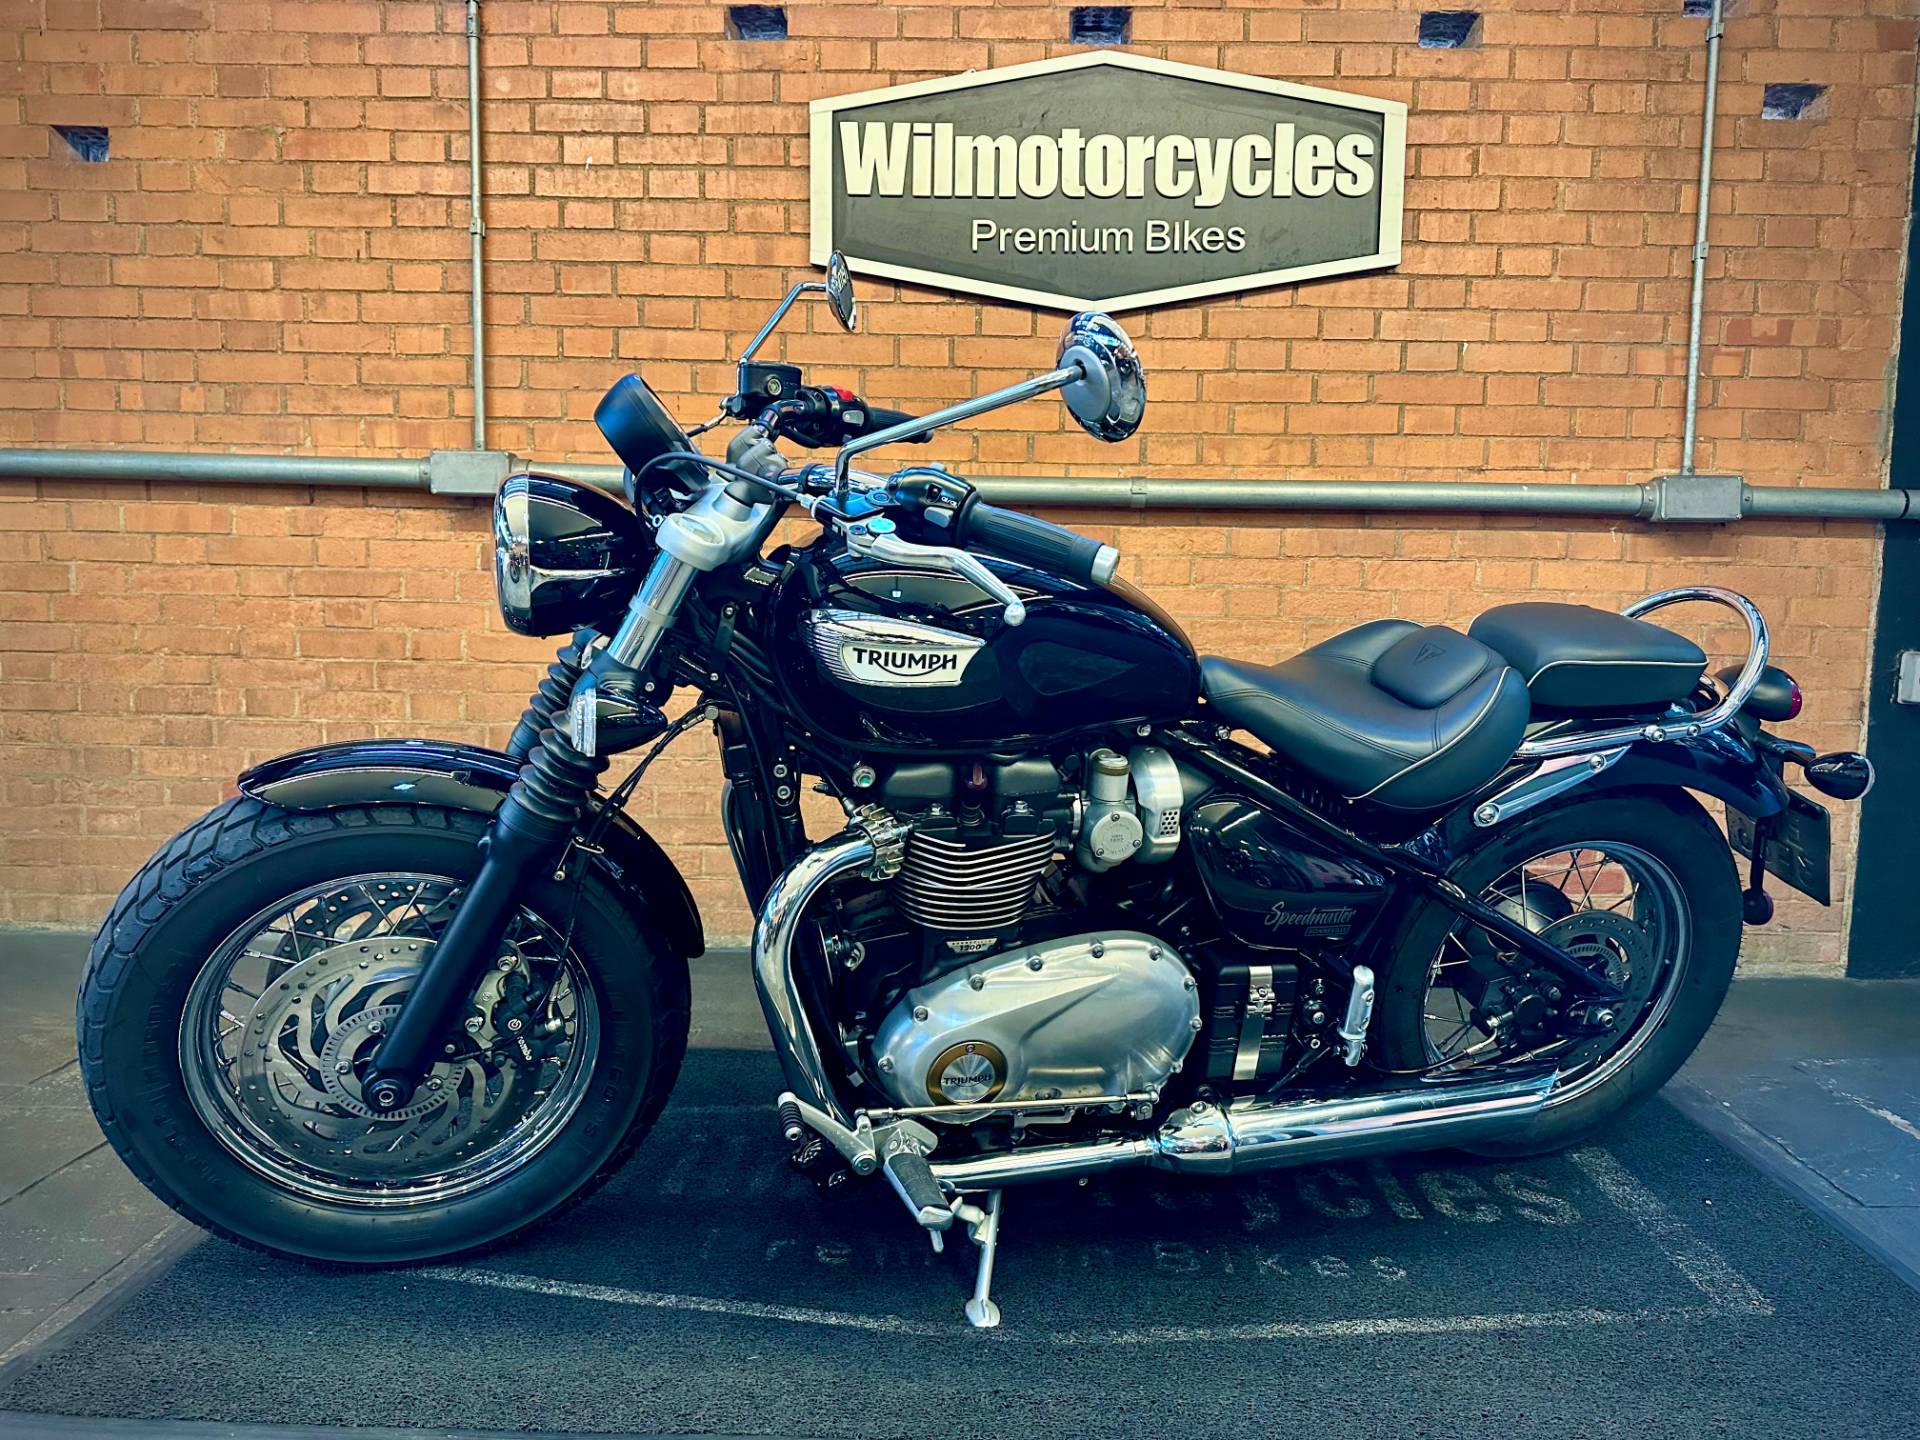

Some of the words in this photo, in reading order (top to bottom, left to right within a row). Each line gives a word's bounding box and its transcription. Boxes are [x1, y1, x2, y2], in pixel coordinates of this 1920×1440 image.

[840, 121, 1375, 207] Wilmotorcycles
[971, 219, 1134, 252] Premium
[853, 647, 957, 674] TRIUMPH
[1264, 901, 1356, 931] Speedmaster
[944, 1076, 992, 1087] TRIUMPH
